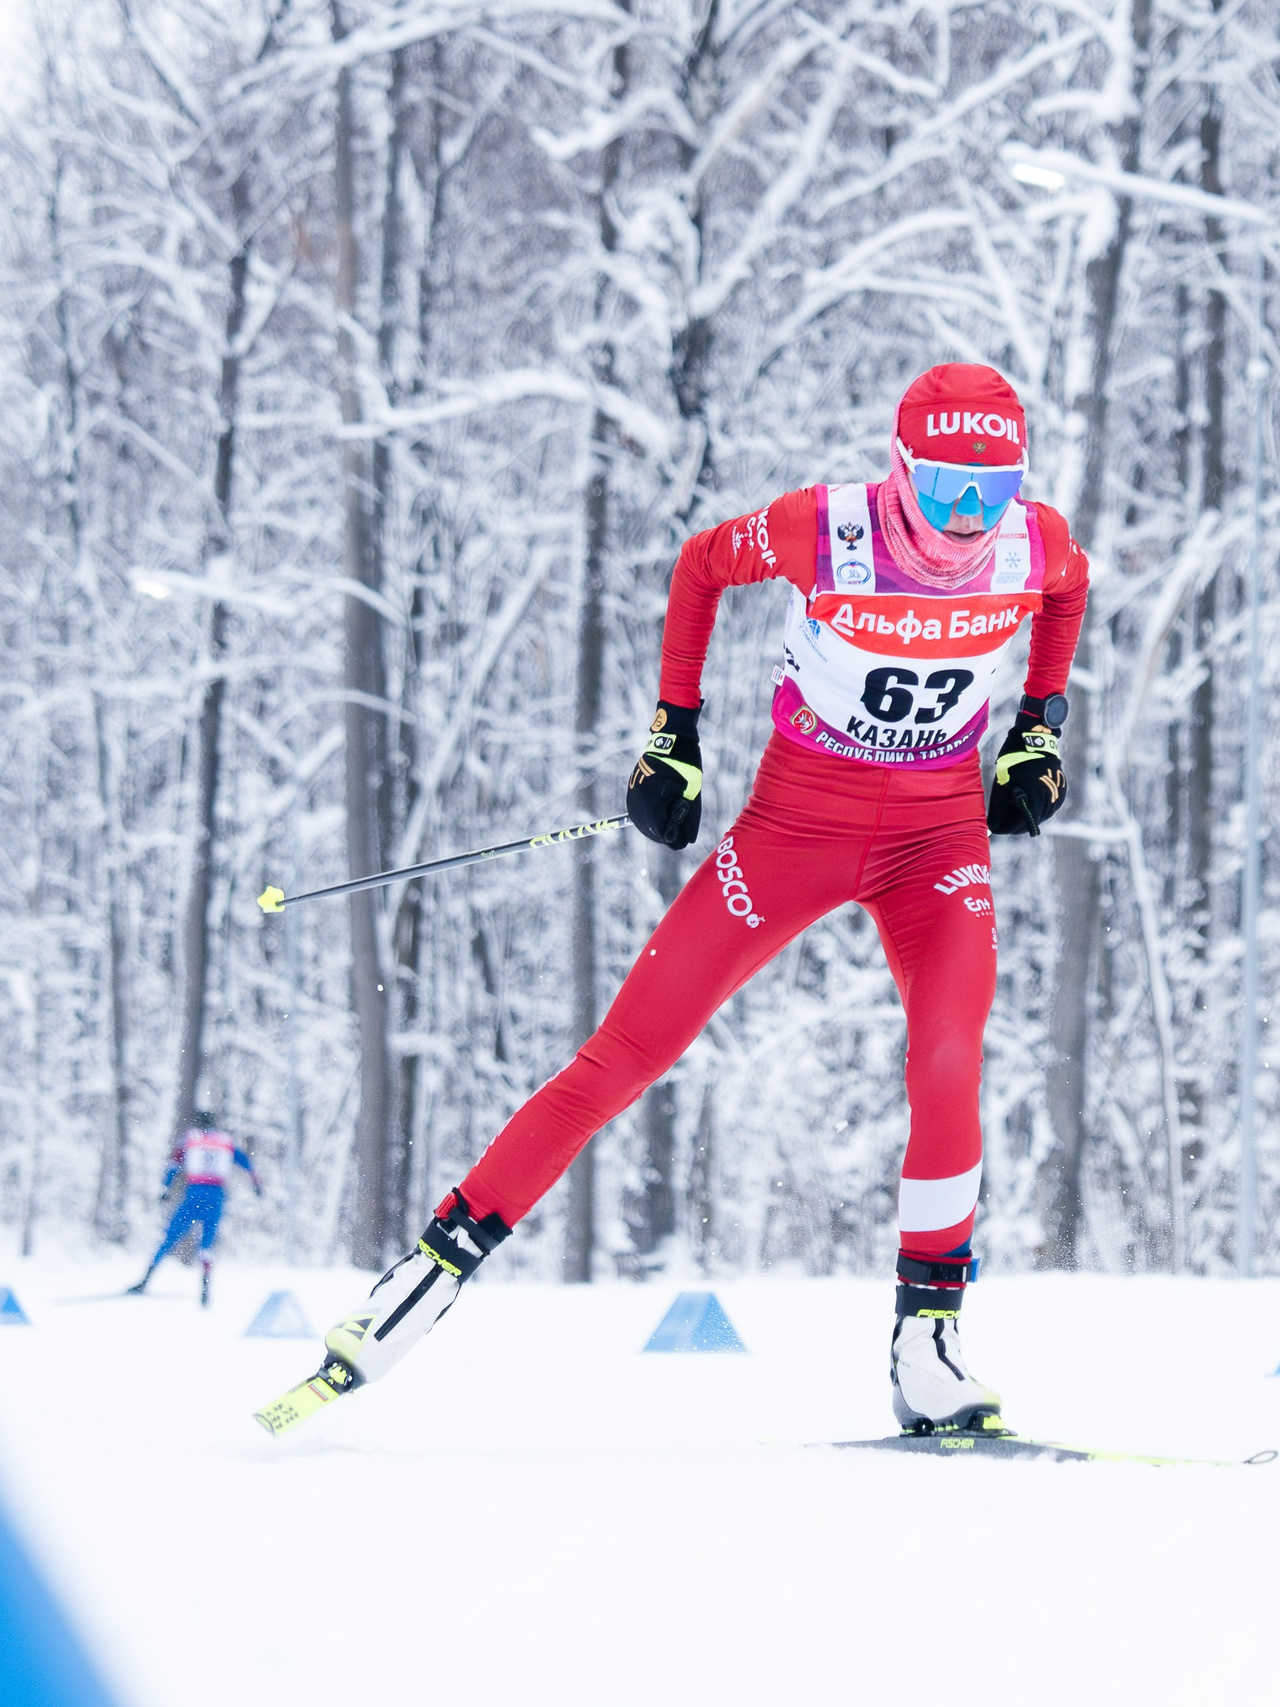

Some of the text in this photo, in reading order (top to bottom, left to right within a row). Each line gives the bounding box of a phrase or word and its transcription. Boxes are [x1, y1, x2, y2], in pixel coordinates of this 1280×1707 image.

[926, 411, 1020, 445] LUKOIL
[830, 603, 1020, 645] Альфа Банк
[860, 667, 975, 725] 63
[815, 730, 915, 763] РЕСПУБЛИКА
[846, 715, 947, 749] КАЗАНЬ
[716, 836, 753, 917] BOSCO
[940, 1438, 975, 1449] FISCHER
